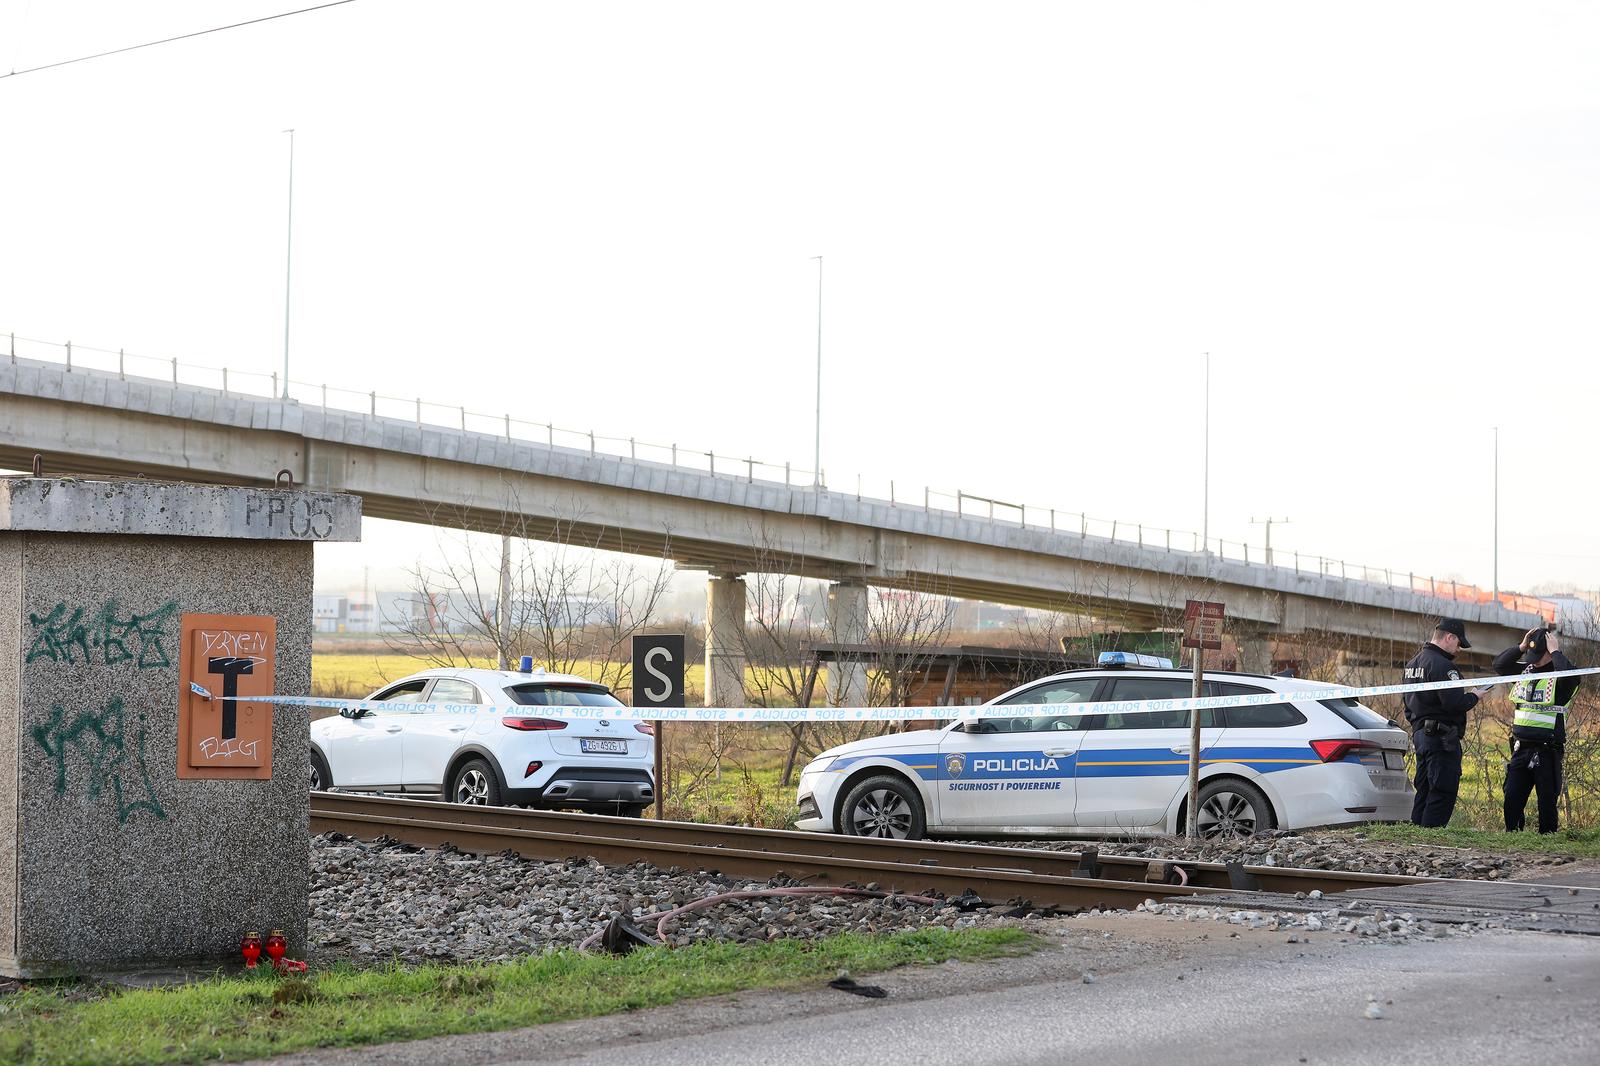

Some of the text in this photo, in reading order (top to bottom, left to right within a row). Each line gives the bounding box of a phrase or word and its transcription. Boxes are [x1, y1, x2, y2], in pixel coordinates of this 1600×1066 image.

[246, 494, 333, 539] PP05
[643, 646, 673, 703] S
[208, 657, 254, 740] T
[587, 740, 597, 750] ZG
[973, 758, 1059, 772] POLICIJA
[949, 783, 999, 791] SIGURNOST
[1006, 781, 1061, 790] POVJERENJE
